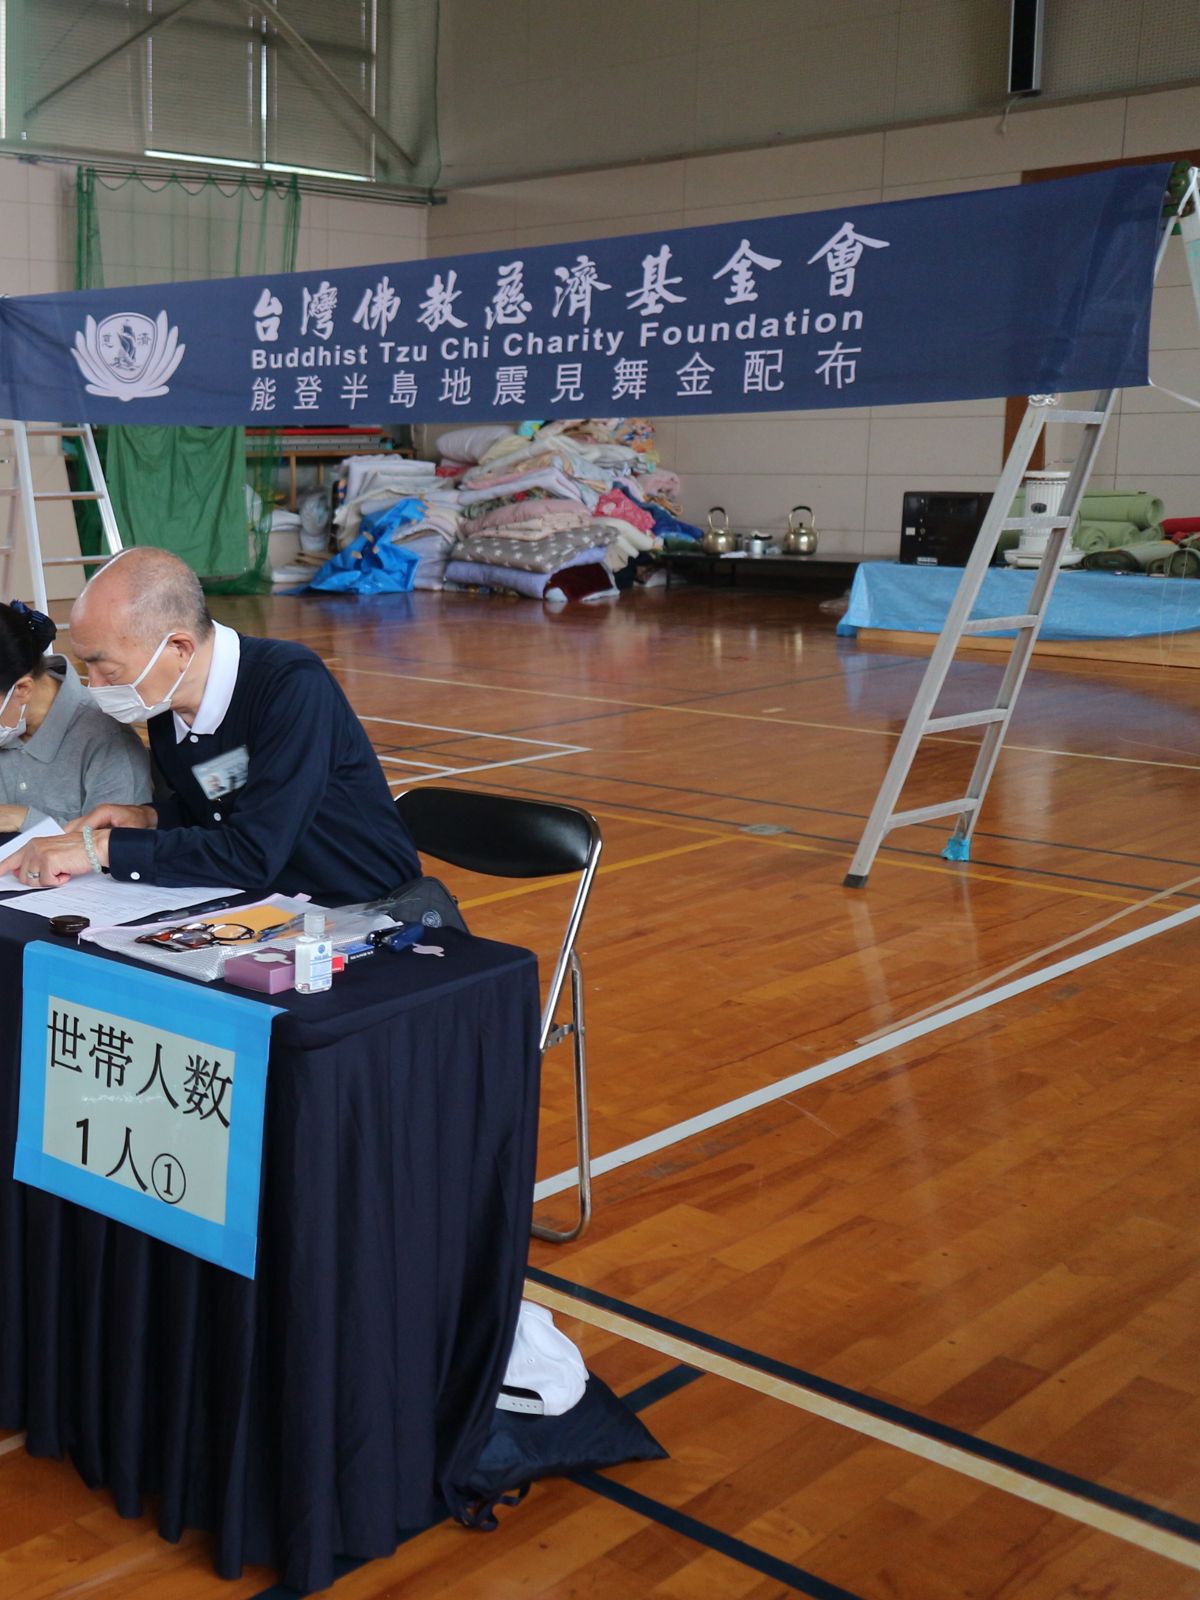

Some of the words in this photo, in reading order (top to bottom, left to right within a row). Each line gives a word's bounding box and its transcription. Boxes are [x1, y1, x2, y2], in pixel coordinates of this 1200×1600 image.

[253, 221, 891, 342] 台灣佛教慈濟基金會
[250, 341, 862, 412] 能登半島地震見舞金配布
[251, 344, 368, 370] Buddhist
[379, 342, 428, 364] Tzu
[441, 335, 489, 360] Chi
[503, 328, 624, 357] Charity
[640, 308, 864, 348] Foundation
[47, 1010, 233, 1128] 世帯人数
